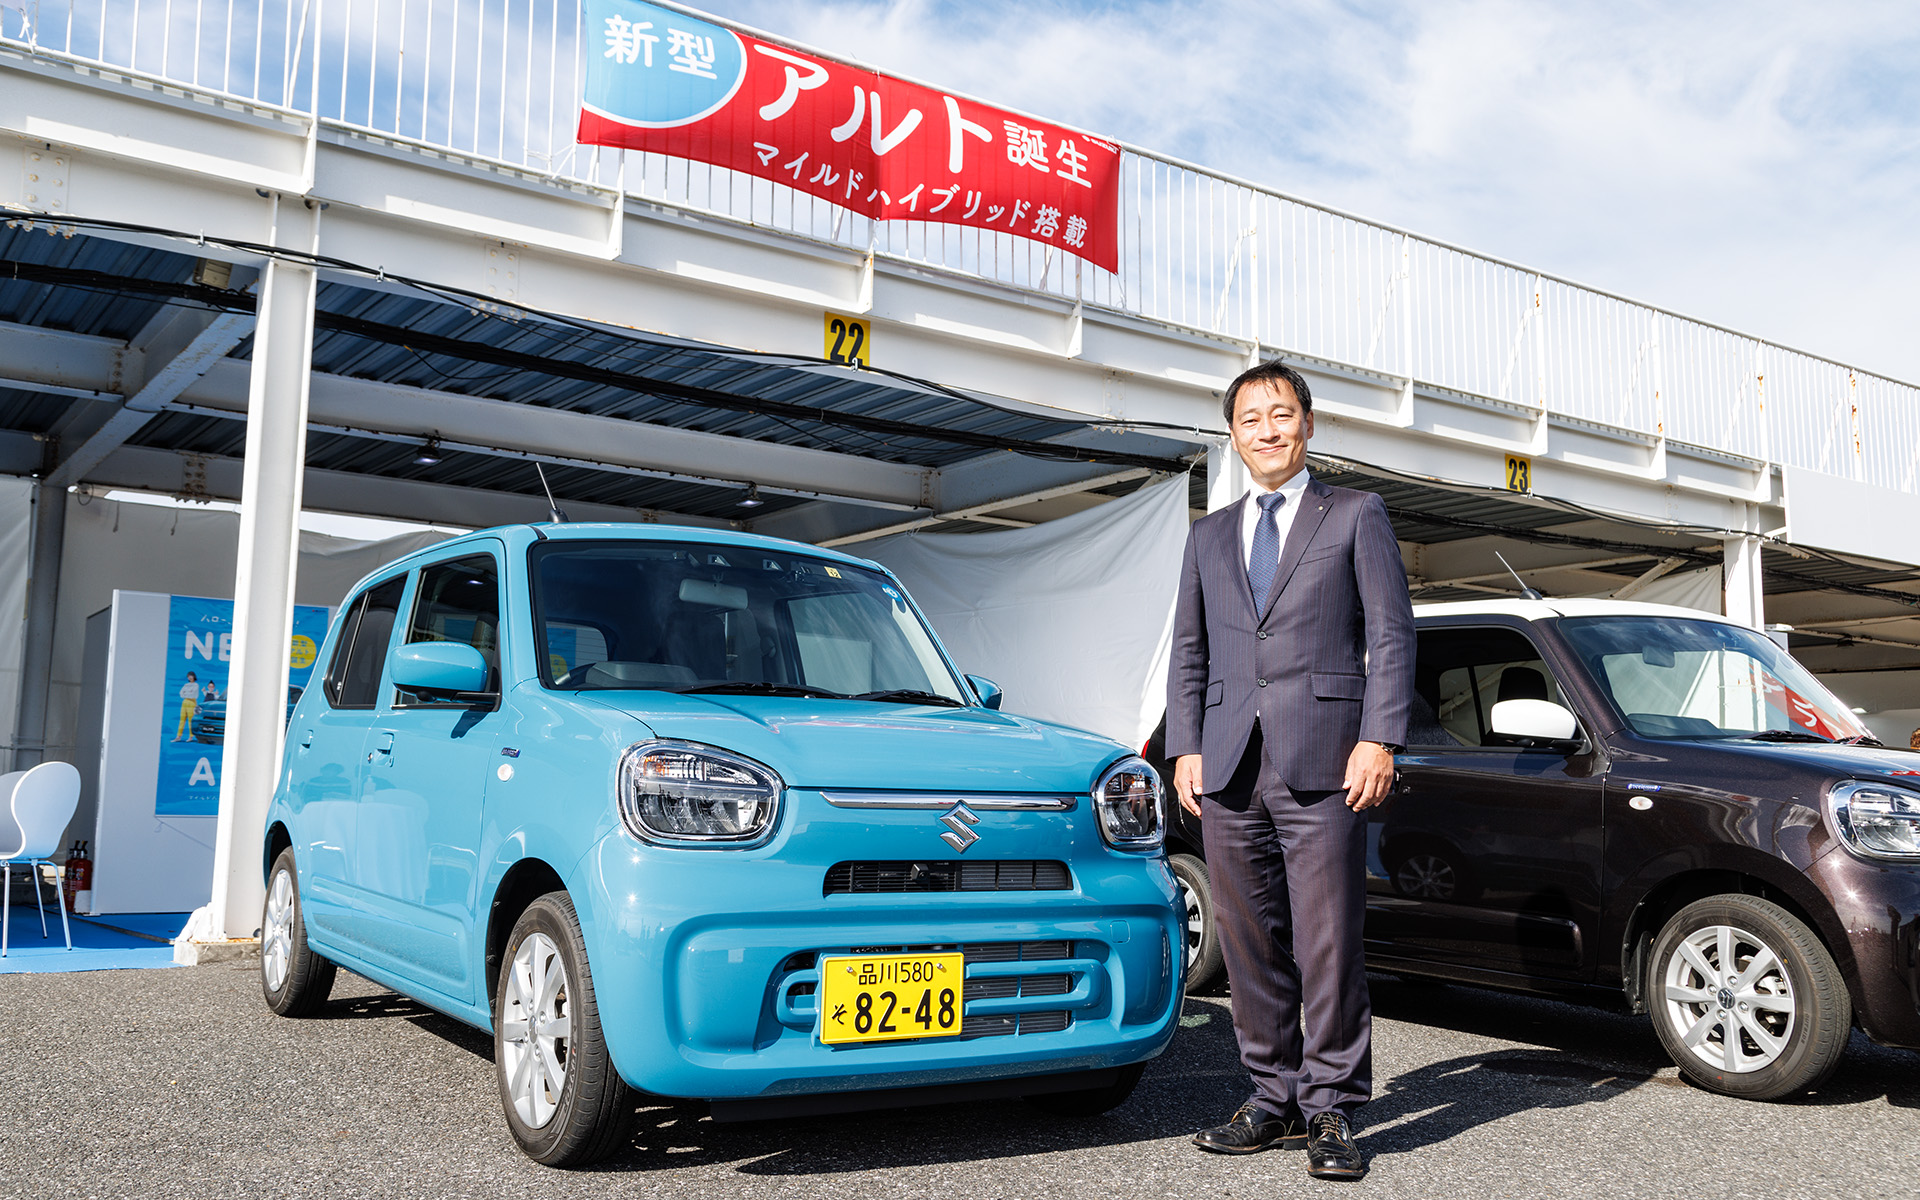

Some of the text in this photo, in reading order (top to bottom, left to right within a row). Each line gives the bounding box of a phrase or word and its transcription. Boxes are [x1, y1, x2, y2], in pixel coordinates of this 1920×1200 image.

[603, 14, 718, 80] 新型
[752, 141, 1088, 249] マイルドハイブリッド搭載
[829, 318, 865, 367] 22
[1508, 458, 1529, 493] 23
[831, 1003, 848, 1025] そ
[854, 988, 956, 1034] 82-48
